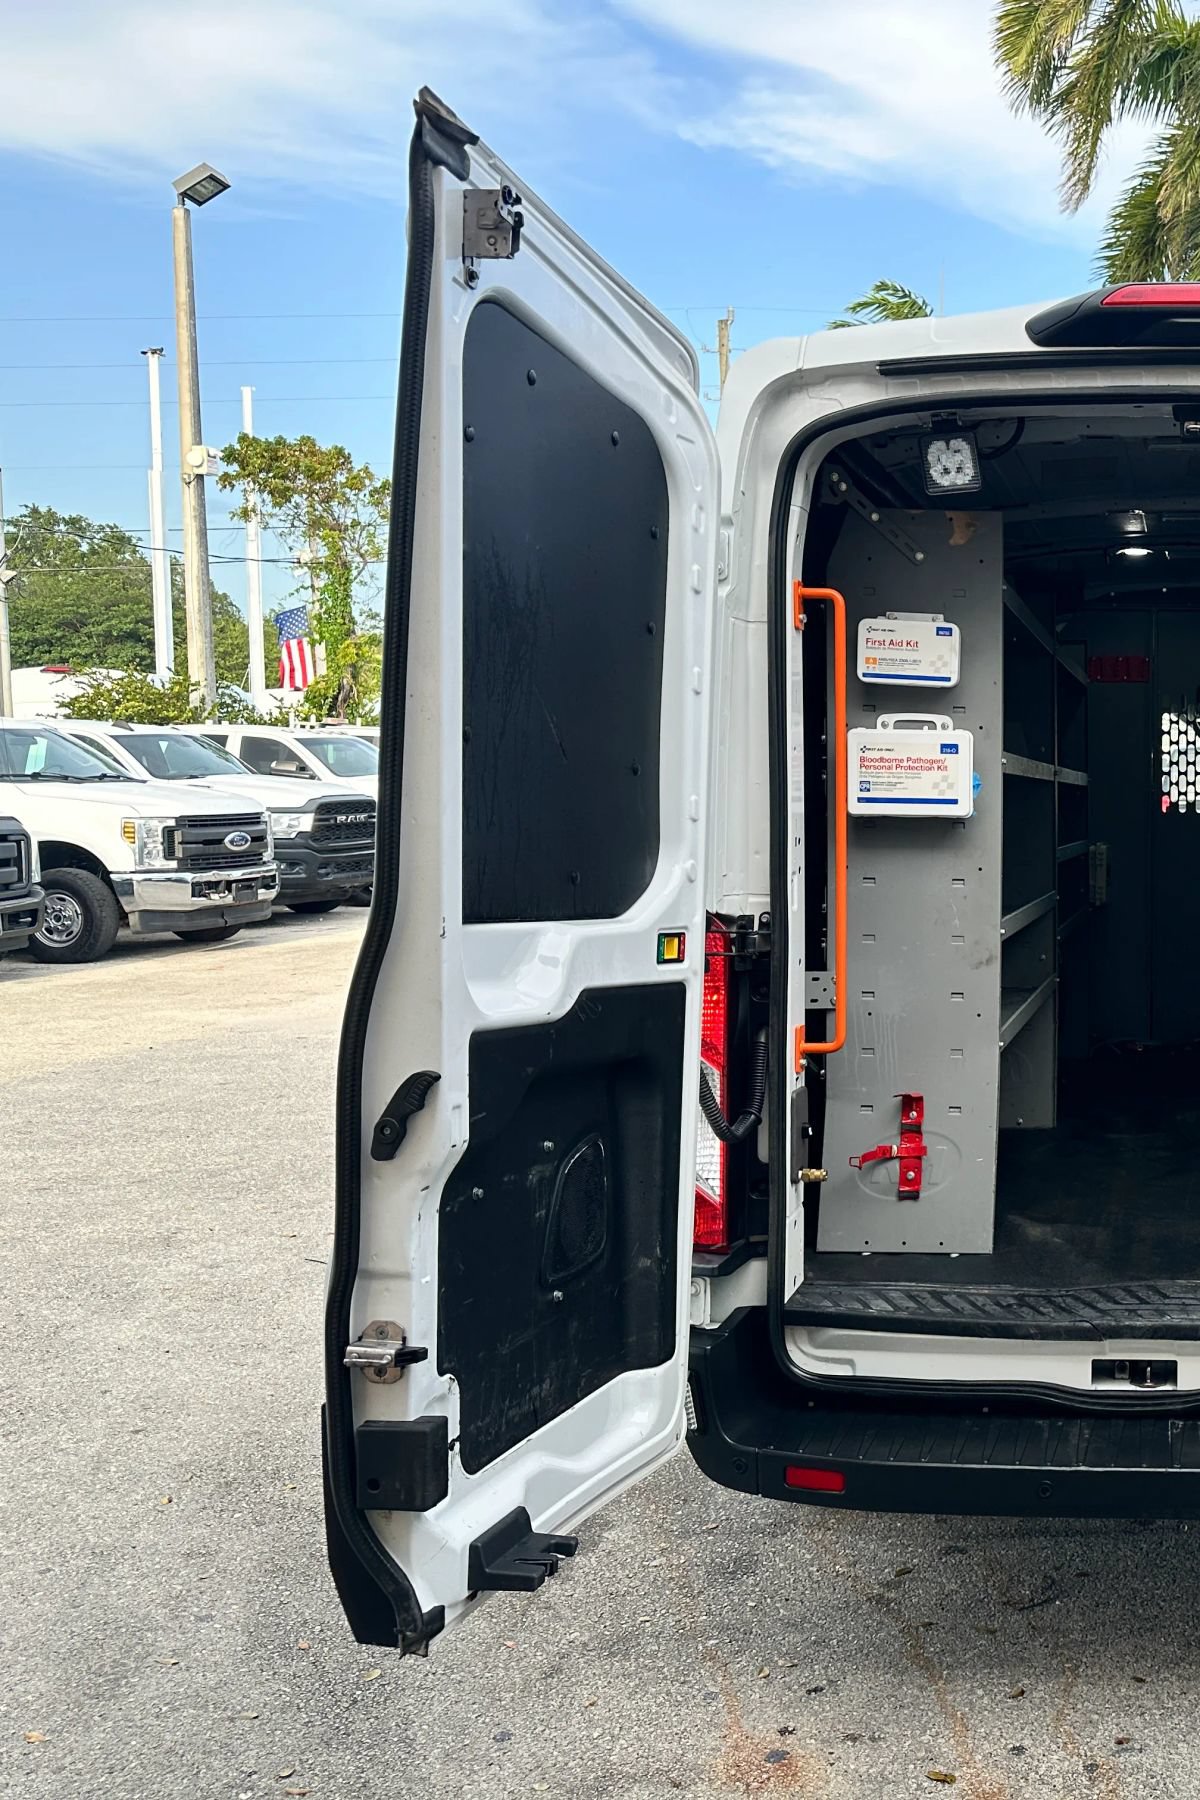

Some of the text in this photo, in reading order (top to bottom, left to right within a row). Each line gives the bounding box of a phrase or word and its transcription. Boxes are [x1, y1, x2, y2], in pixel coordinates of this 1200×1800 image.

[865, 637, 919, 648] First Aid Kit
[859, 756, 947, 766] Bloodborne Pathogen/
[859, 763, 948, 772] Personal Protection Kit
